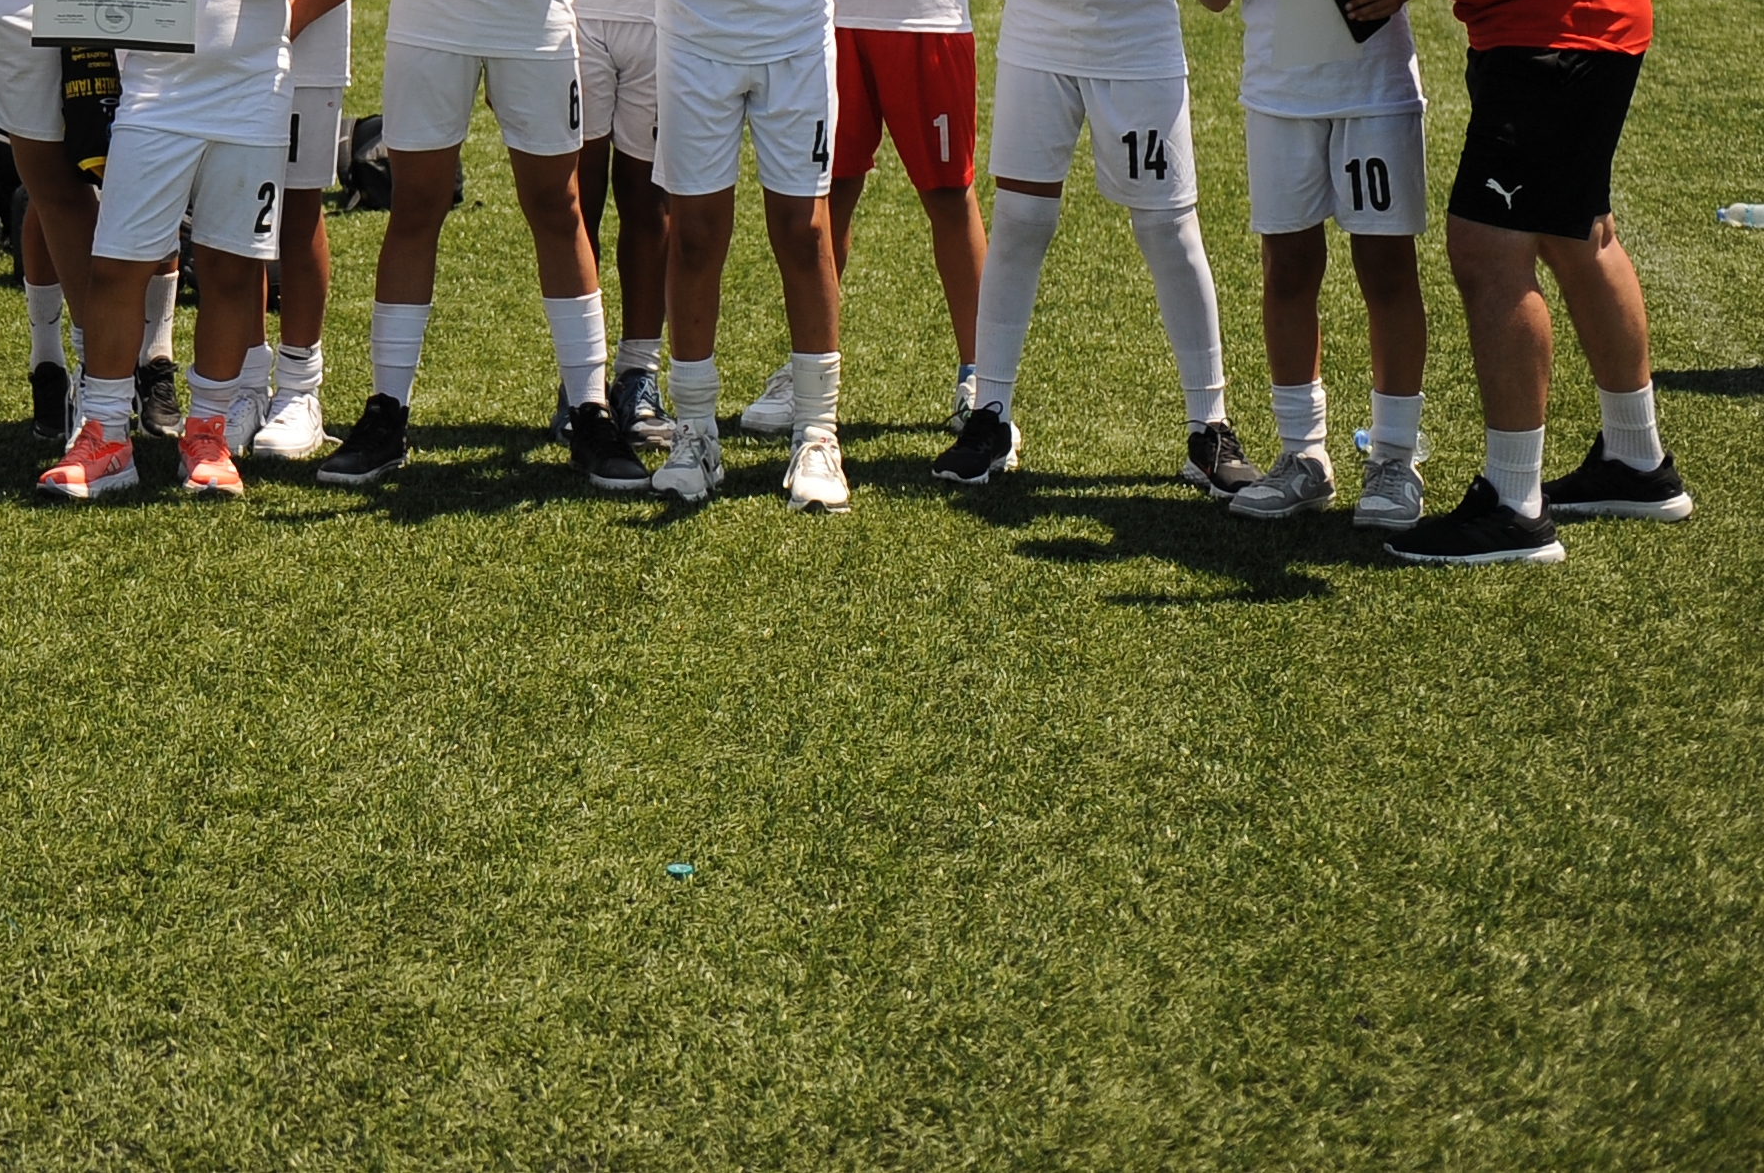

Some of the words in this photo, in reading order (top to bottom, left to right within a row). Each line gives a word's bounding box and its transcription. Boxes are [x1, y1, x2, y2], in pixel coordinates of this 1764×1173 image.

[569, 79, 580, 130] 6
[812, 120, 829, 172] 4
[933, 113, 950, 162] 1
[1122, 130, 1167, 180] 14
[254, 182, 276, 233] 2
[1345, 158, 1391, 211] 10
